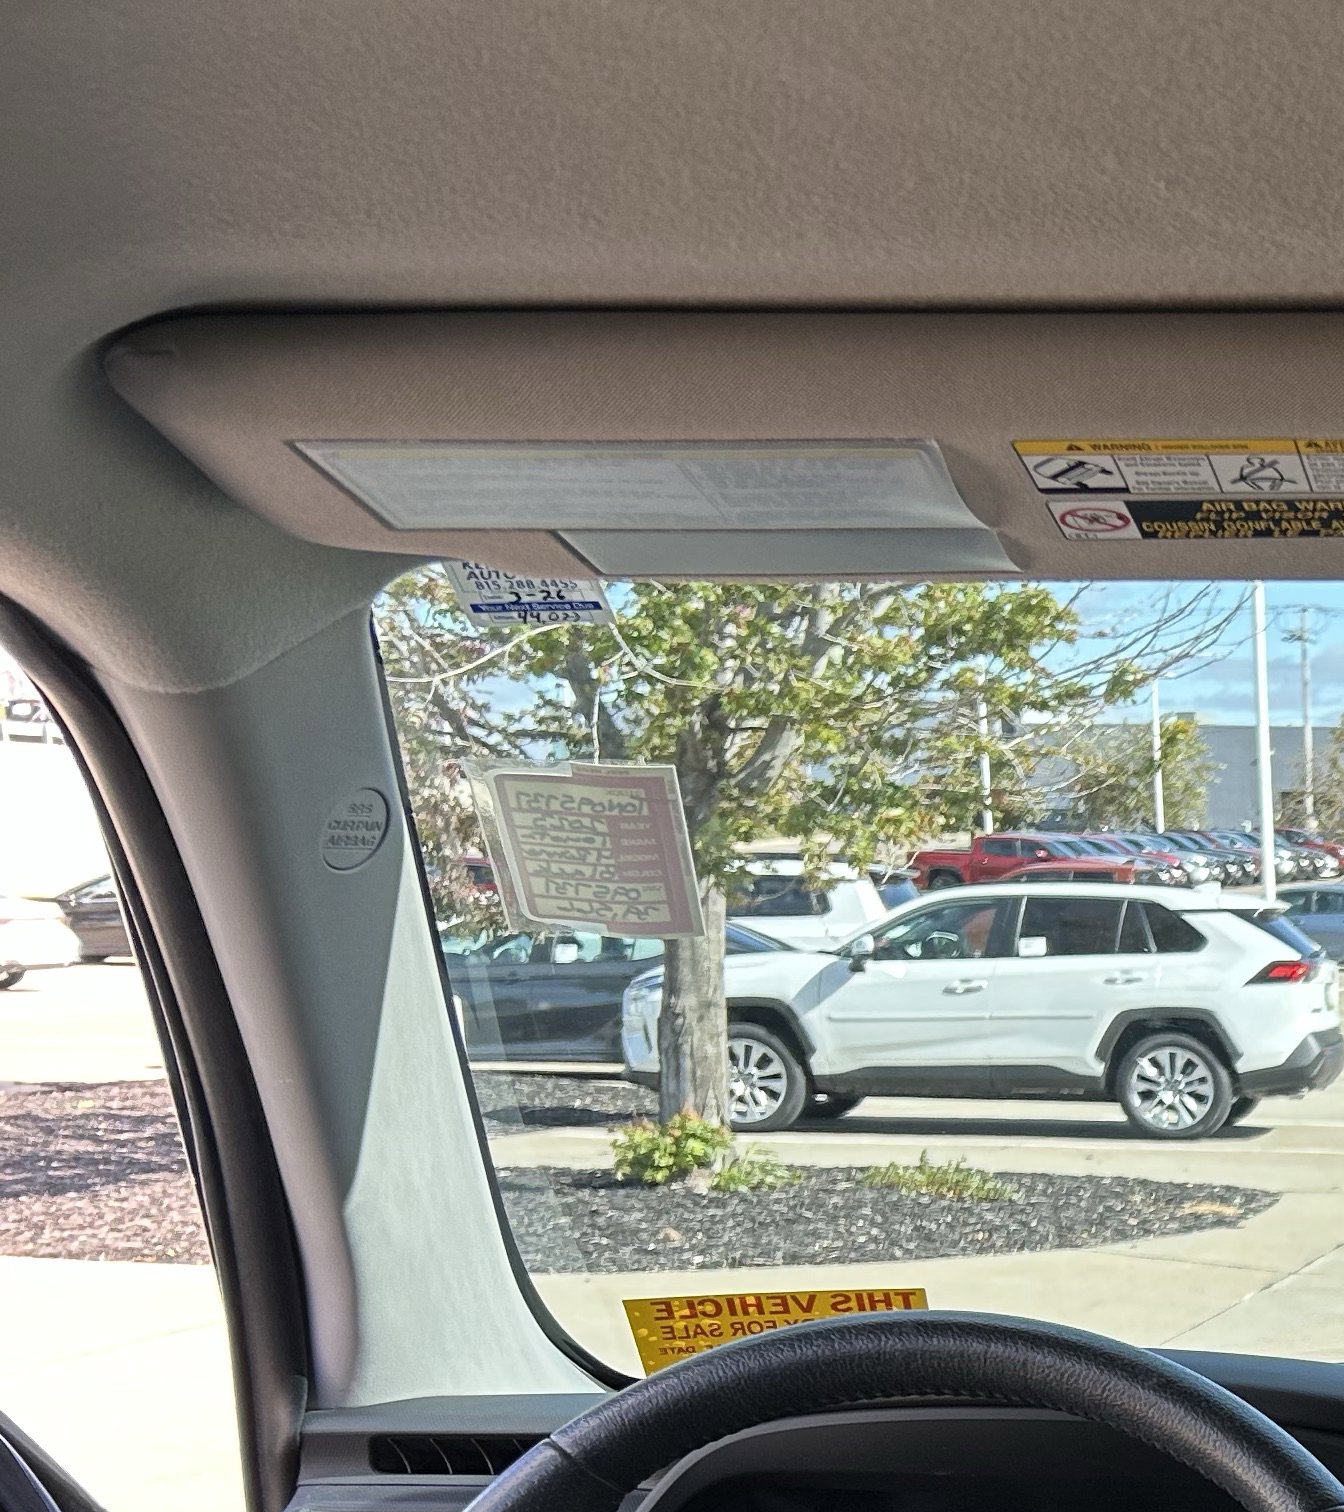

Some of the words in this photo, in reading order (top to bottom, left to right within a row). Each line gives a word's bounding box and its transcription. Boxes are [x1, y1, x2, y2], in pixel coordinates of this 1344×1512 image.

[1089, 443, 1152, 451] WARNING
[1201, 501, 1235, 512] AIR
[1242, 501, 1288, 512] BAG
[327, 820, 383, 832] CURTAIN
[328, 835, 377, 847] AIRBAG
